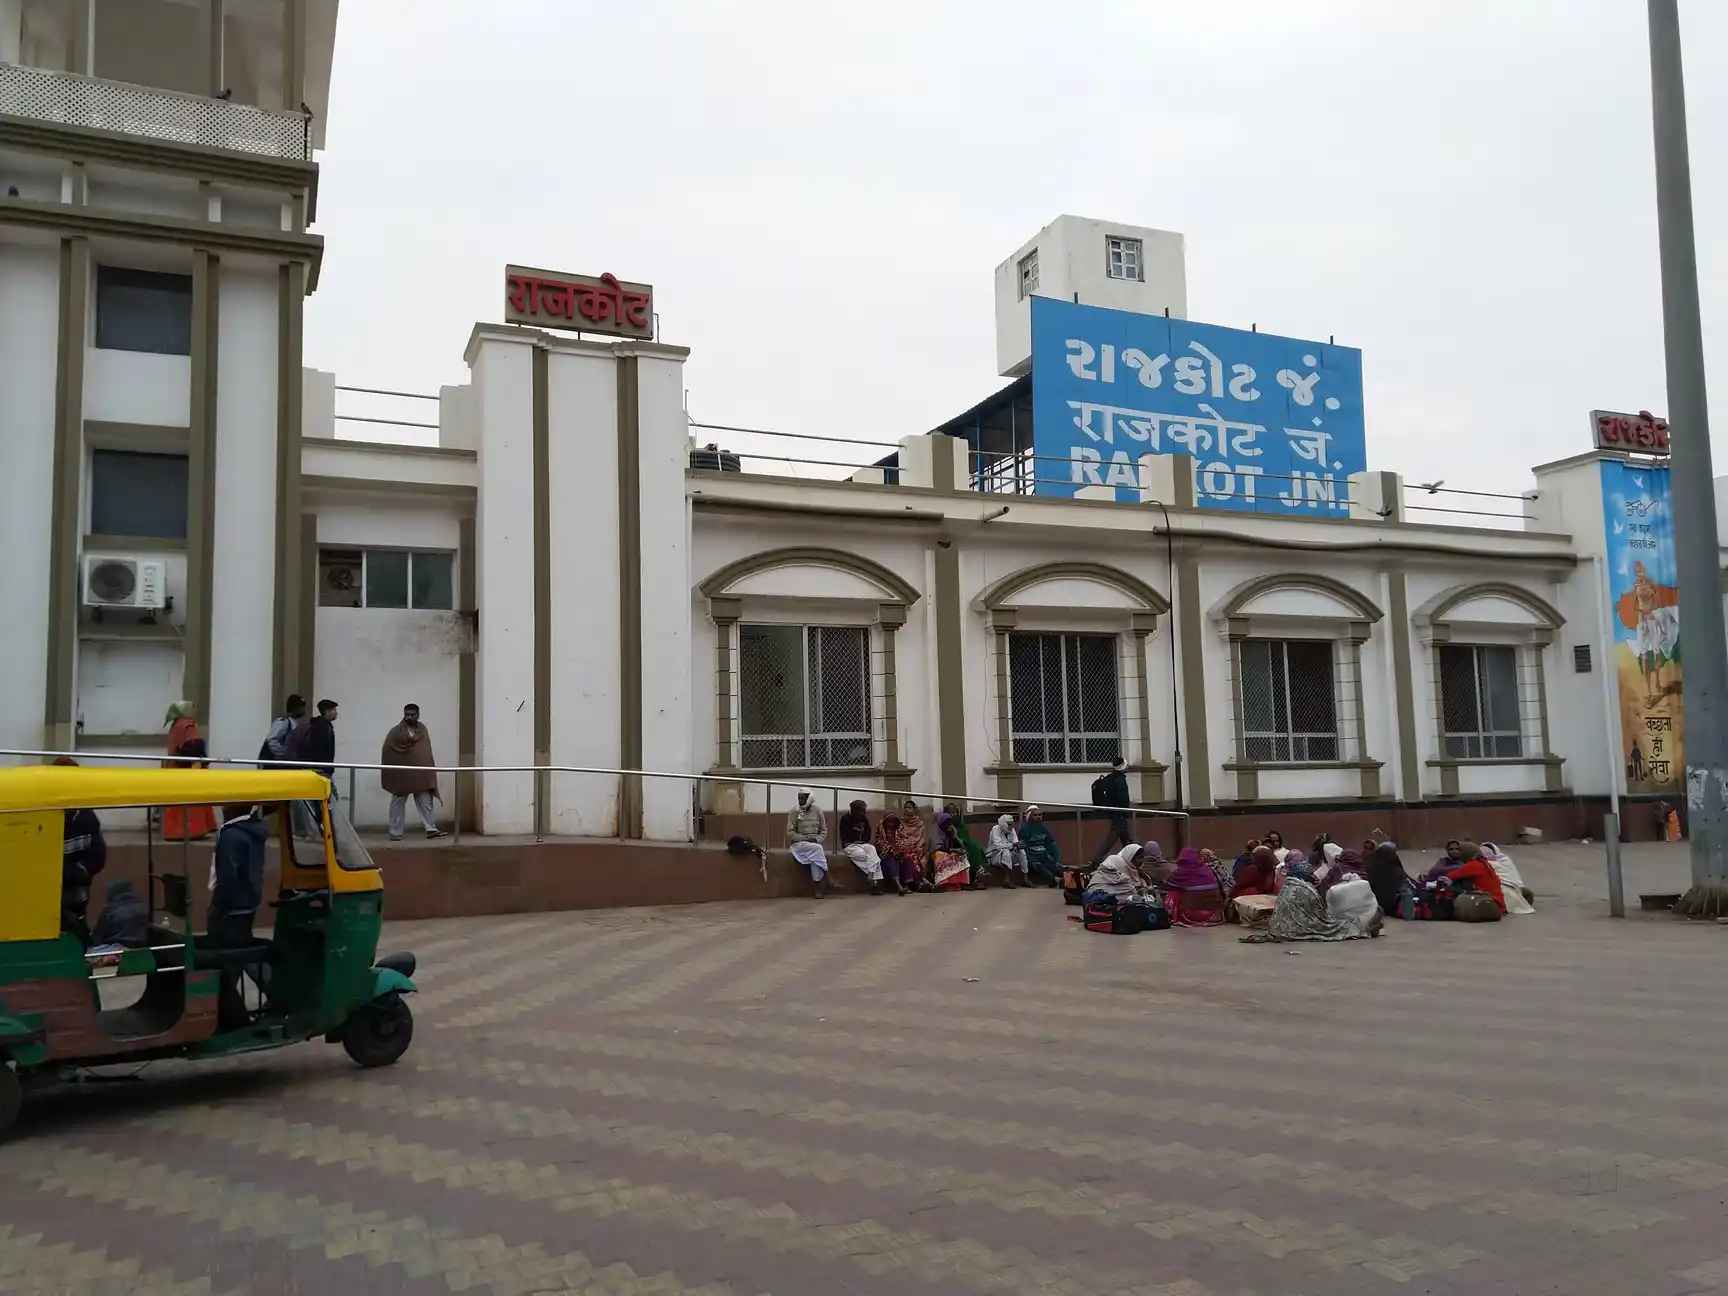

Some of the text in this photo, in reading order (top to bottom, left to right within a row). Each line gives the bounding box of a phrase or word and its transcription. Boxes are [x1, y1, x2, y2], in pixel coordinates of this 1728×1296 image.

[508, 272, 650, 328] राजकोट
[1065, 339, 1262, 402] રાજકોટ
[1065, 400, 1344, 471] राजकोट जं.
[1070, 446, 1263, 503] RAOT
